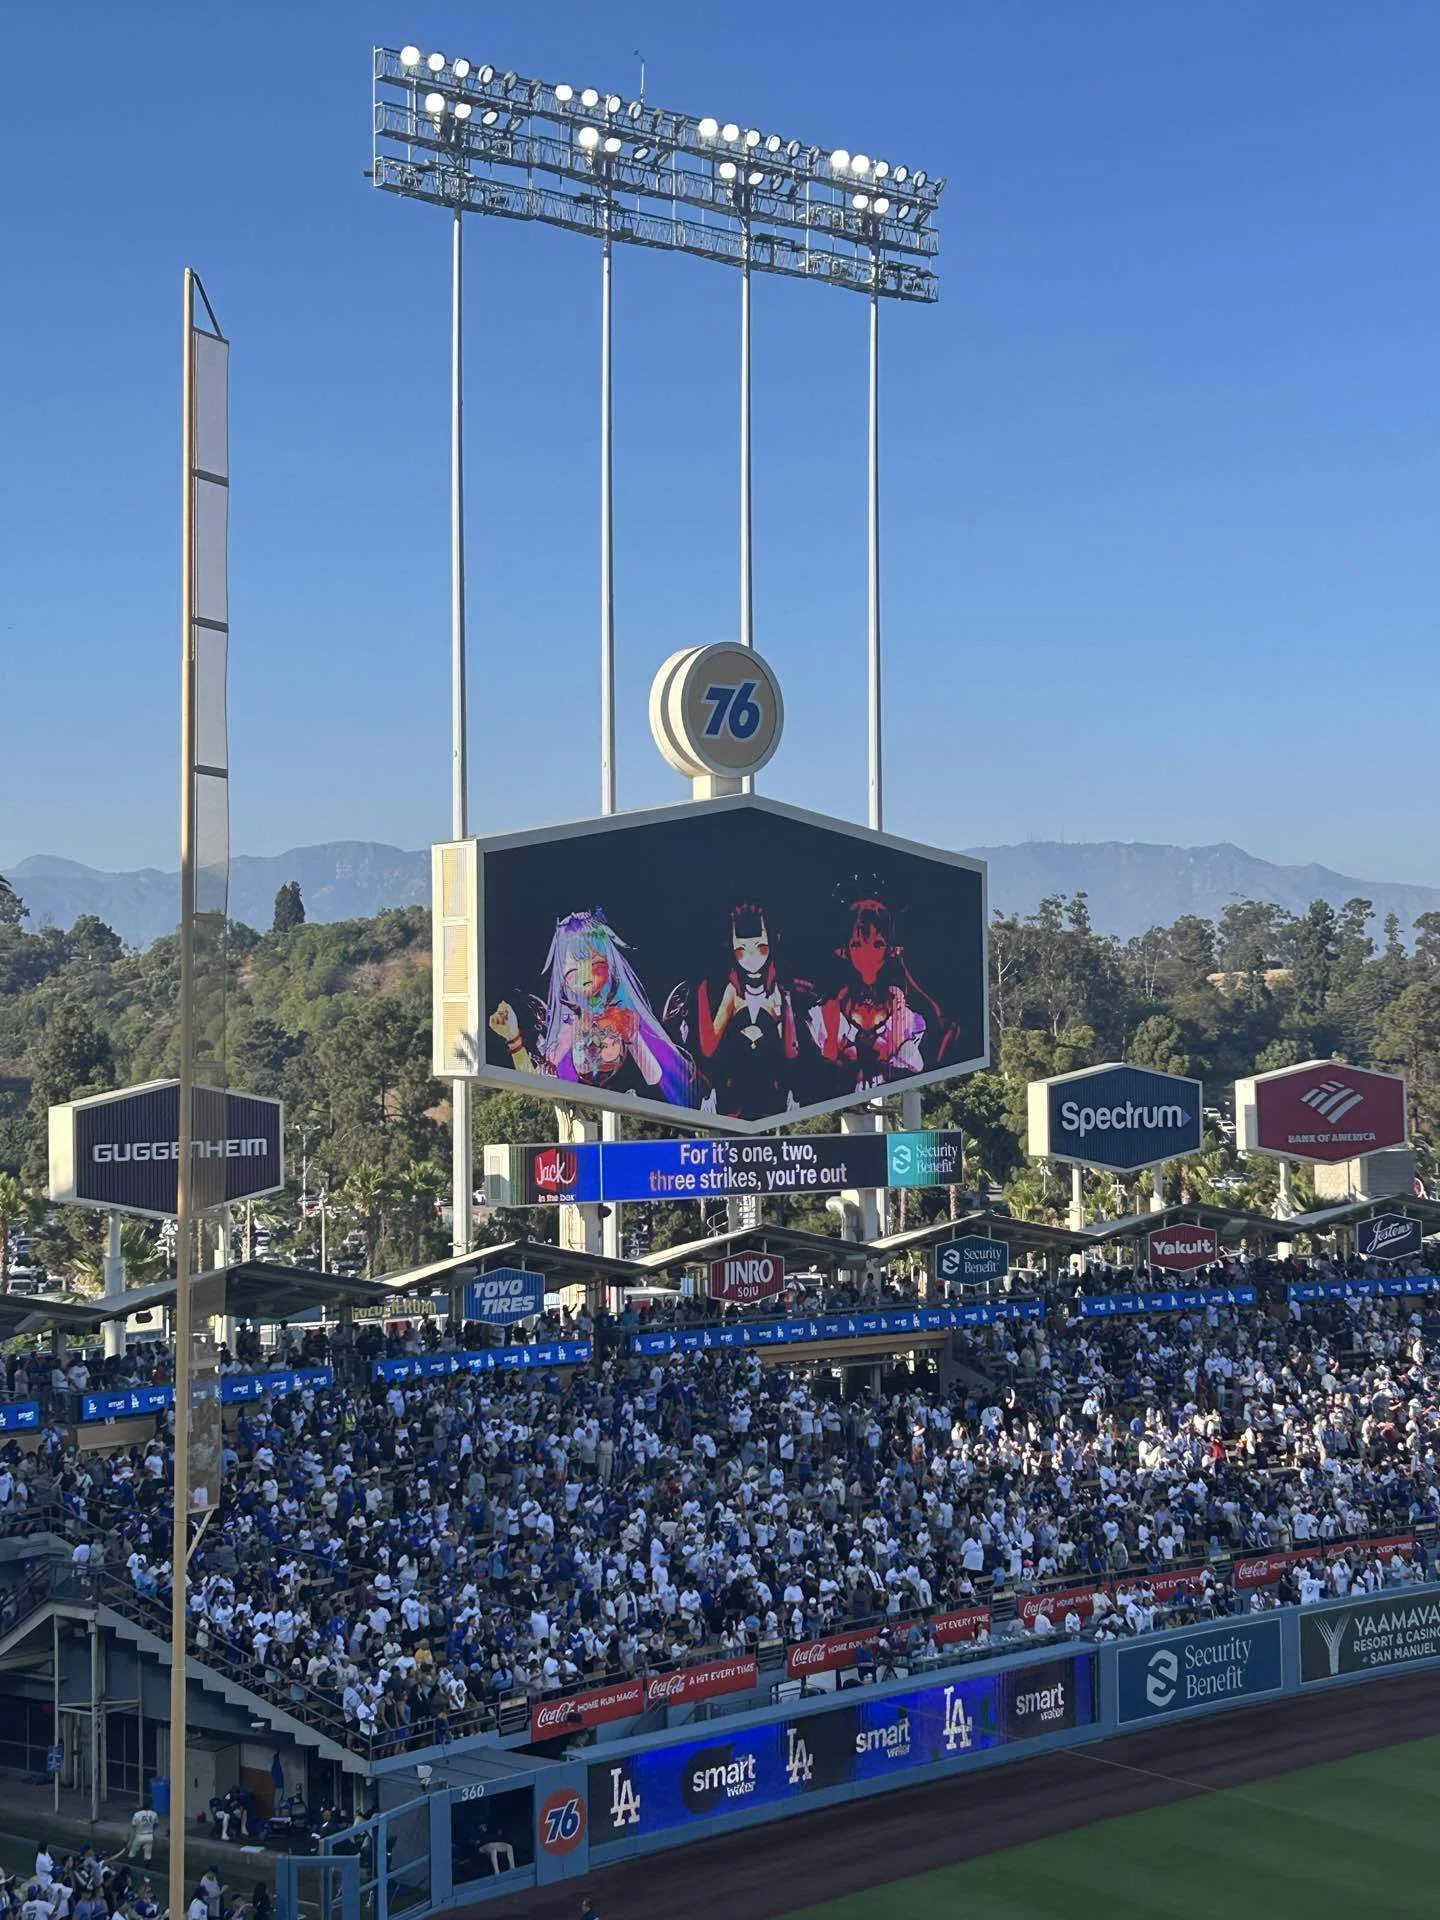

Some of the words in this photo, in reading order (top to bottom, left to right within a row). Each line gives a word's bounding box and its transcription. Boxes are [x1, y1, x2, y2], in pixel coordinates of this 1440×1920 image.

[703, 680, 761, 740] 76
[1061, 1101, 1183, 1137] Spectrum
[1288, 1134, 1317, 1143] BANK
[1318, 1134, 1330, 1142] OF
[1331, 1133, 1376, 1141] AMERICA
[680, 1144, 708, 1165] For
[712, 1142, 739, 1163] it's
[742, 1146, 777, 1165] one,
[781, 1141, 817, 1163] two,
[916, 1142, 958, 1162] Security
[536, 1152, 577, 1185] Jack
[649, 1169, 696, 1191] three
[700, 1166, 761, 1190] strikes,
[766, 1164, 817, 1190] you're
[820, 1163, 847, 1183] out
[917, 1159, 953, 1173] Benefit
[963, 1247, 1002, 1260] Security
[1152, 1239, 1213, 1255] Yakult
[722, 1259, 773, 1293] JINRO
[964, 1259, 997, 1273] Benefit
[474, 1279, 523, 1298] TOYO
[737, 1286, 759, 1297] SOJU
[481, 1295, 535, 1315] TIRES
[949, 1615, 971, 1629] EVERY
[1185, 1637, 1251, 1669] Security
[1353, 1634, 1394, 1652] RESORT
[1396, 1632, 1404, 1645] &
[1370, 1650, 1391, 1664] SAN
[1394, 1642, 1437, 1659] MANUEL
[792, 1643, 826, 1667] Coca-Cola
[649, 1675, 685, 1699] Coca-Cola
[689, 1676, 695, 1685] A
[696, 1673, 709, 1684] HIT
[711, 1666, 735, 1680] EVERY
[737, 1662, 755, 1675] TIME
[1185, 1665, 1243, 1699] Benefit
[577, 1700, 599, 1712] HOME
[601, 1694, 616, 1706] RUN
[617, 1689, 639, 1702] MAGIC
[1016, 1682, 1064, 1715] smart
[943, 1686, 972, 1750] LA
[856, 1717, 911, 1753] smart
[786, 1728, 813, 1784] LA
[693, 1754, 756, 1792] smart
[461, 1785, 485, 1801] 360
[610, 1768, 640, 1827] LA
[545, 1798, 581, 1844] 76
